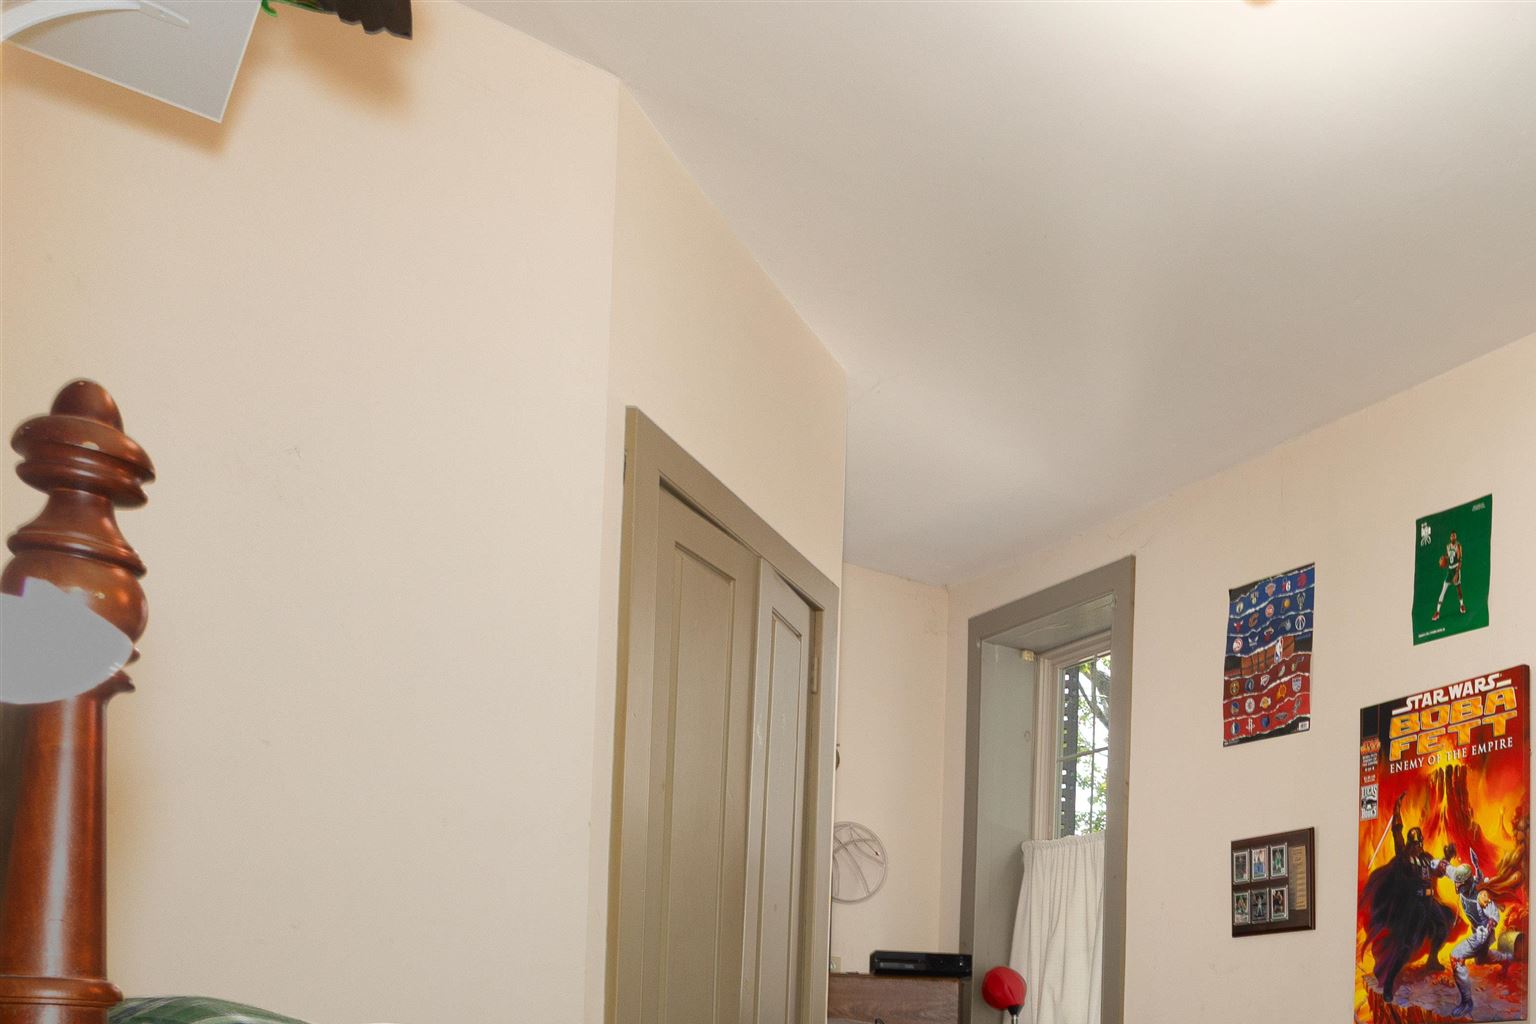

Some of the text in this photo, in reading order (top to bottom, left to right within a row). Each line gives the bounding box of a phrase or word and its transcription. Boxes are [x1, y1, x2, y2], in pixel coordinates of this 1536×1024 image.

[1389, 686, 1517, 739] BOBA
[1391, 673, 1512, 715] STAR WARS
[1389, 710, 1517, 762] FETT
[1390, 755, 1425, 774] ENEMY
[1427, 753, 1441, 766] OF
[1446, 747, 1467, 760] THE
[1471, 736, 1513, 756] EMPIRE
